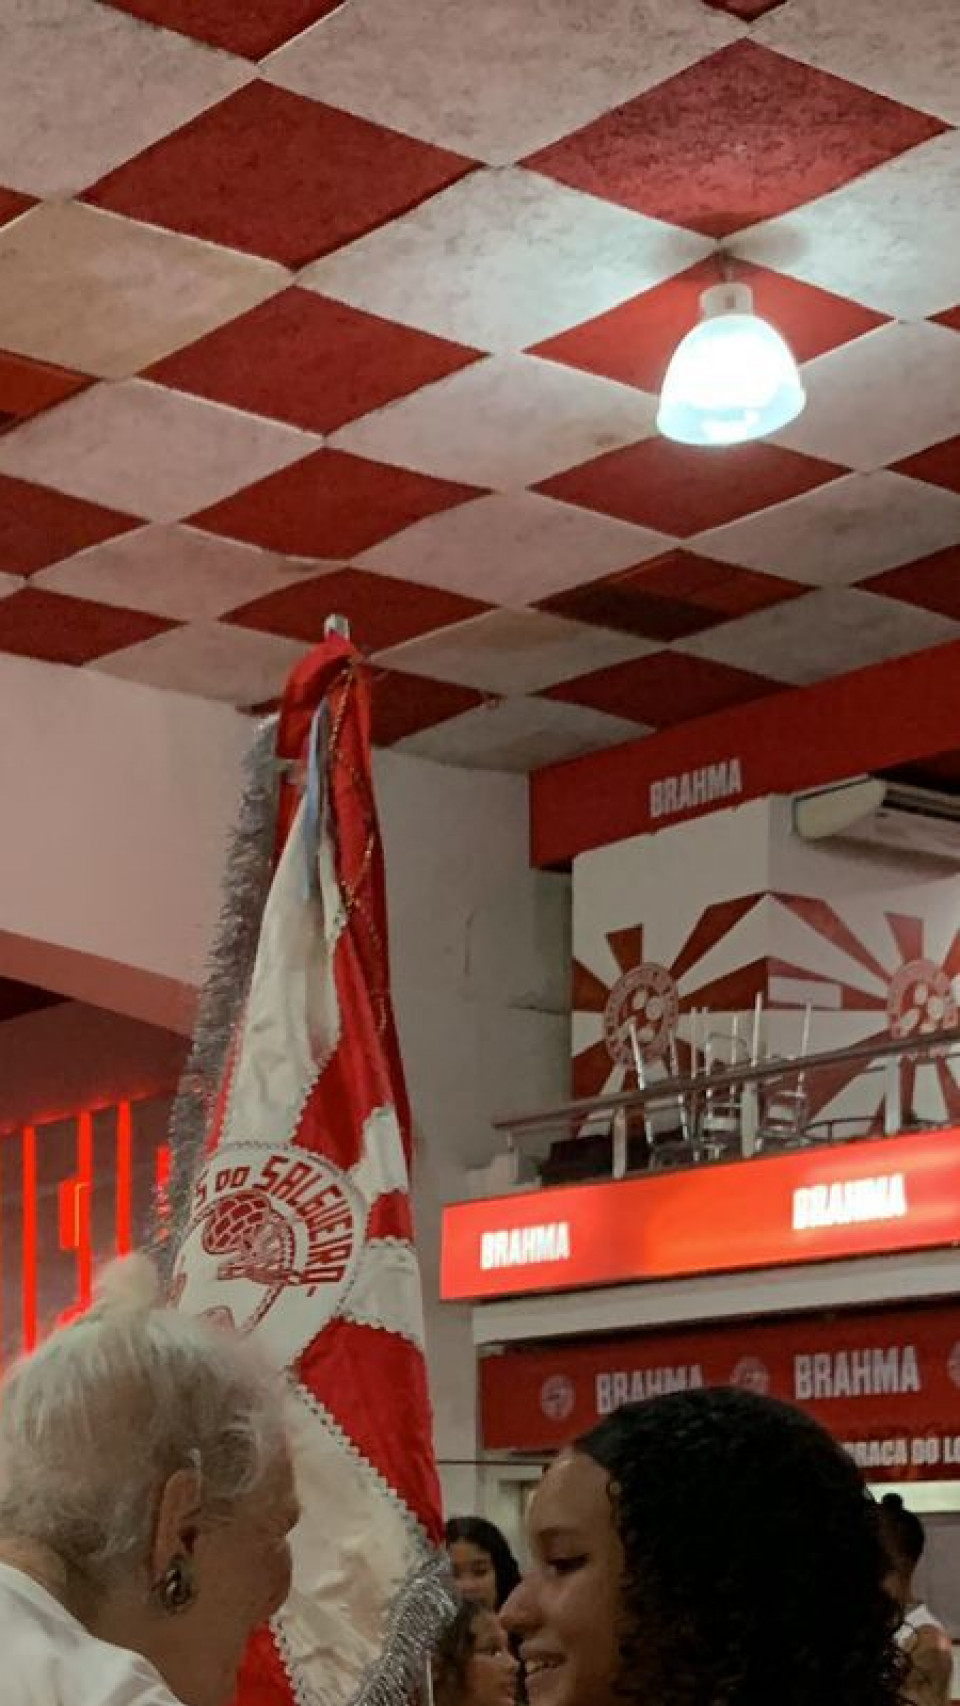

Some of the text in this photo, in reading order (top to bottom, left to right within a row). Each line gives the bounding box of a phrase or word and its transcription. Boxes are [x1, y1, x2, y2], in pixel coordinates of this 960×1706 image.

[649, 758, 742, 818] BRAHMA
[791, 1173, 907, 1230] BRAHMA
[480, 1222, 570, 1270] BRAHMA
[795, 1345, 921, 1399] BRAHMA
